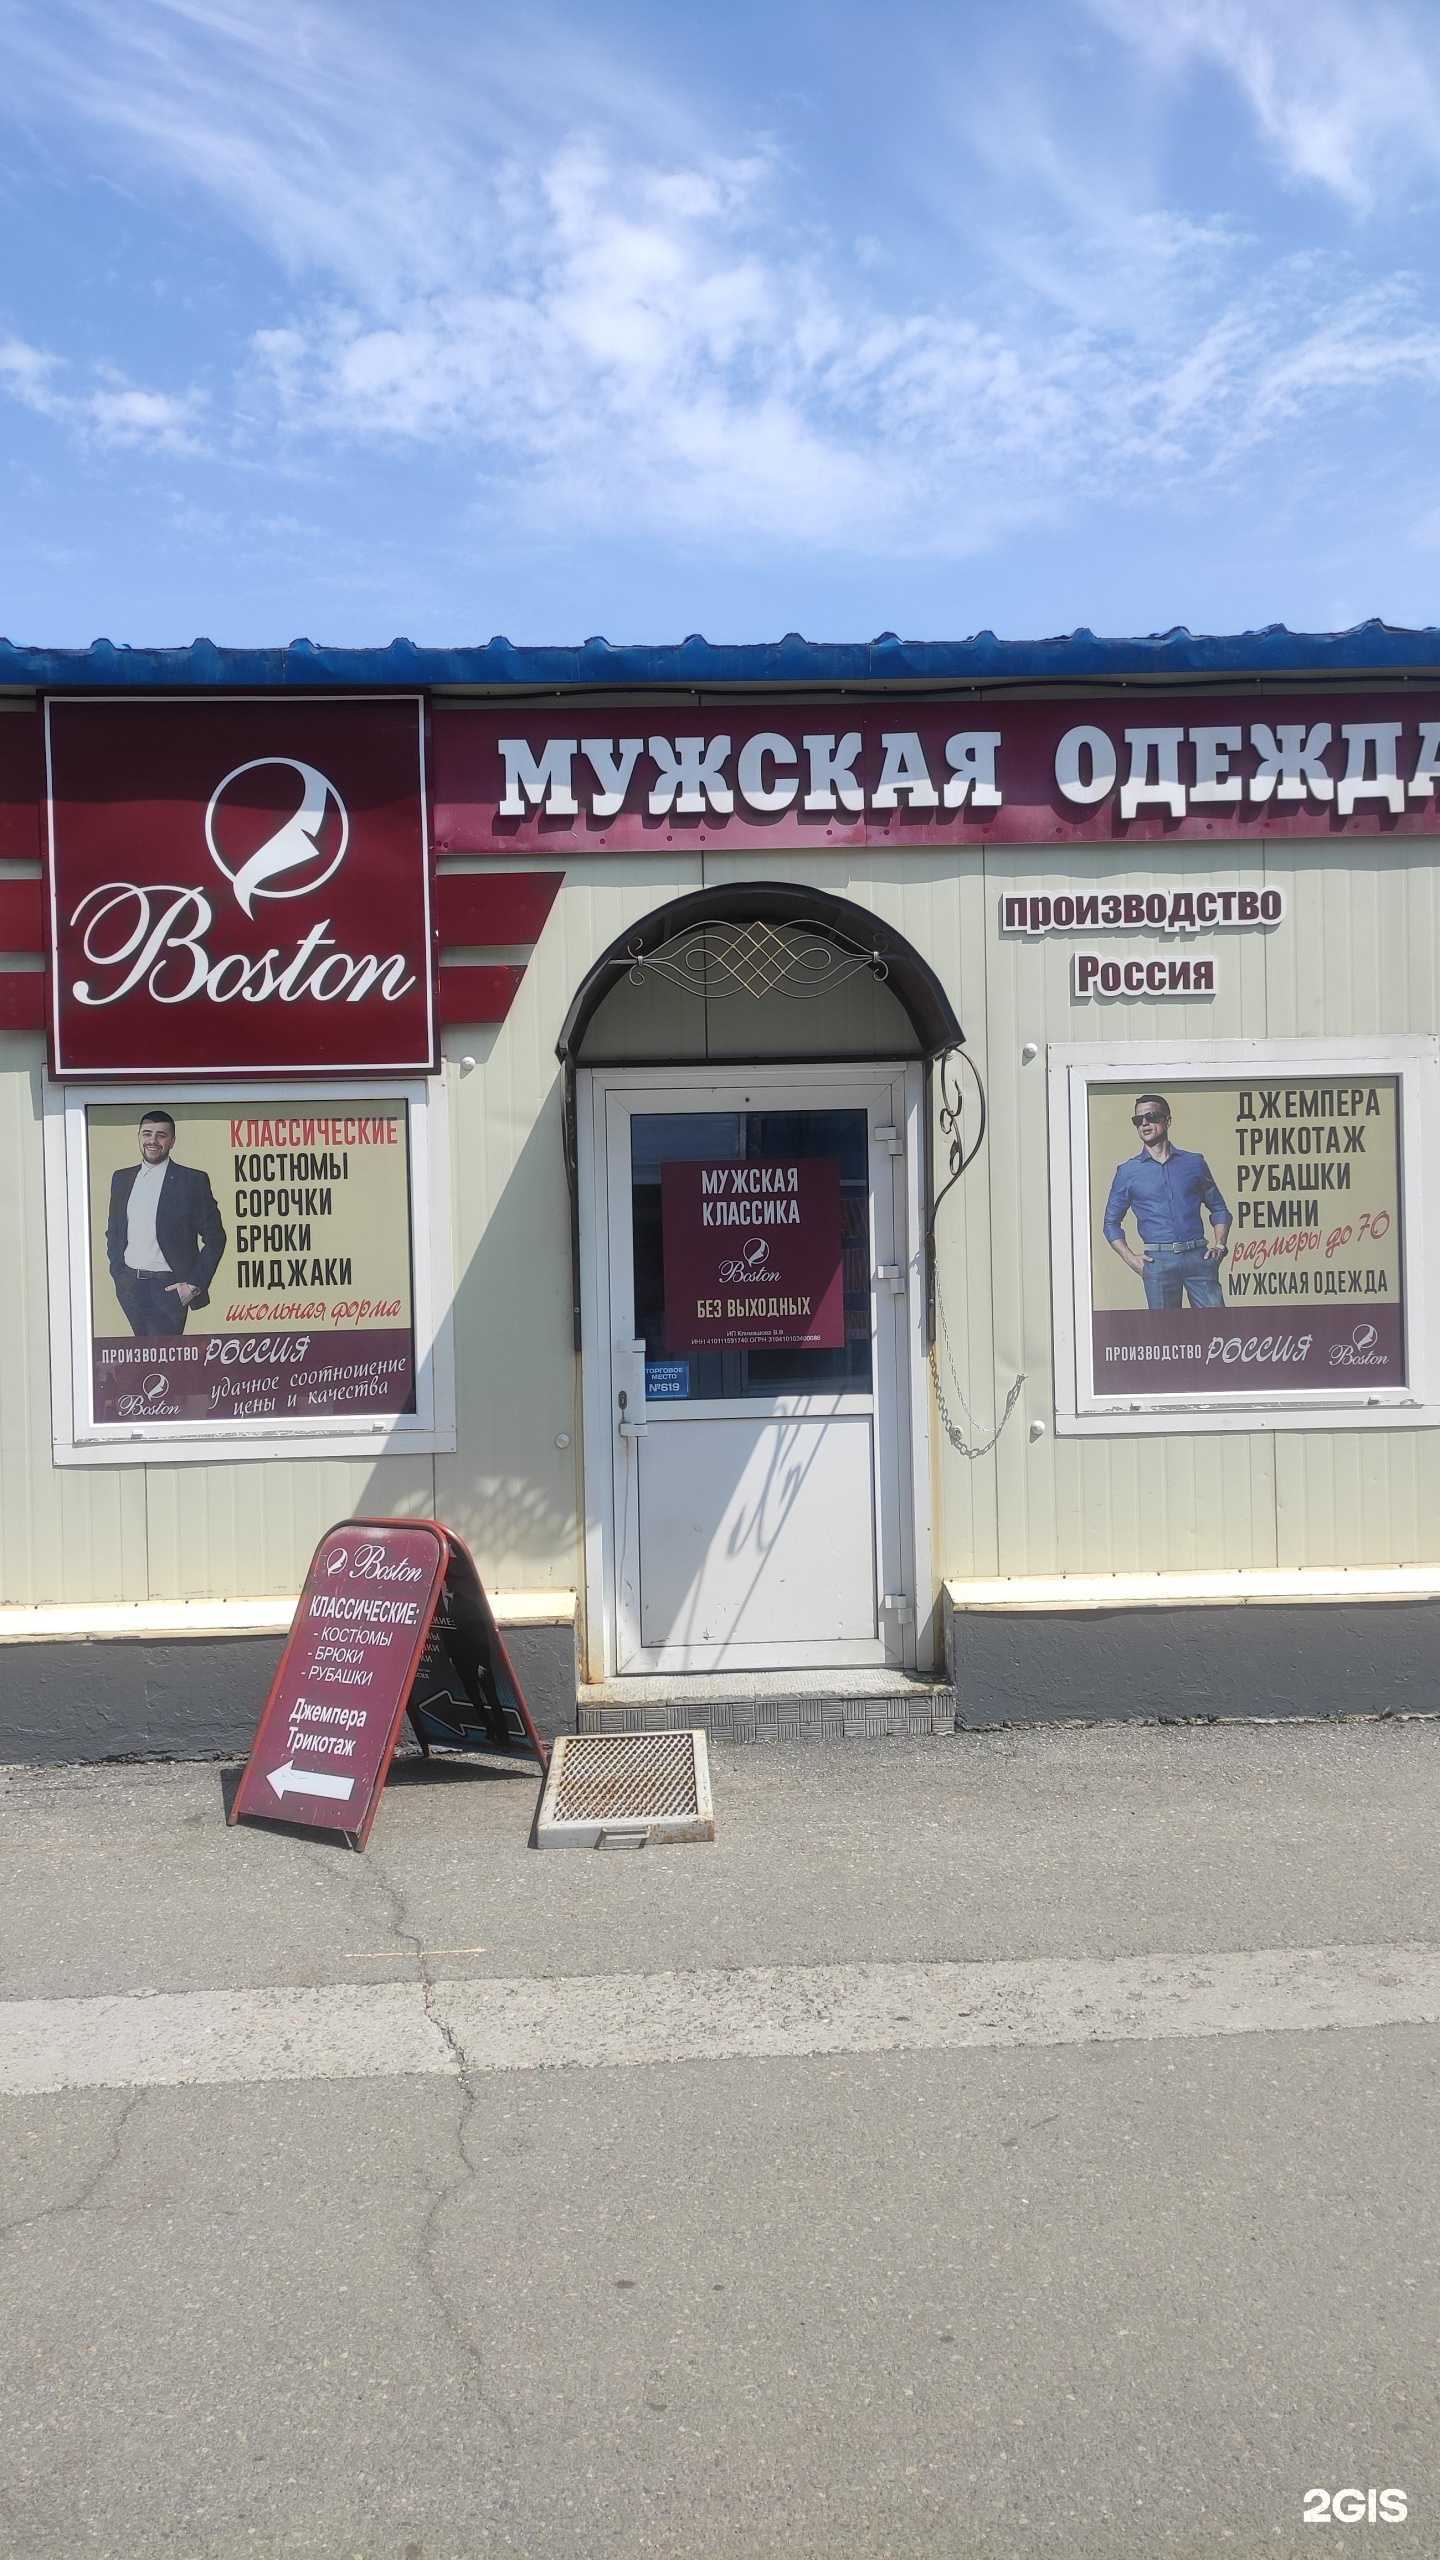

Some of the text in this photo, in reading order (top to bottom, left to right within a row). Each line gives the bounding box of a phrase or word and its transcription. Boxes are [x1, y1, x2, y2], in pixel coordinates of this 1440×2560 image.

[498, 731, 1002, 817] МУЖСКАЯ
[69, 882, 417, 1006] Boston
[1077, 955, 1215, 992] Россия
[1236, 1088, 1381, 1122] ДЖЕМПЕРА
[230, 1116, 398, 1148] КЛАССИЧЕСКИЕ
[1235, 1125, 1367, 1156] ТРИКОТАЖ
[234, 1152, 349, 1182] КОСТЮМЫ
[701, 1168, 799, 1194] МУЖСКАЯ
[1237, 1162, 1351, 1192] РУБАШКИ
[235, 1188, 332, 1217] СОРОЧКИ
[702, 1200, 800, 1226] КЛАССИКА
[1238, 1200, 1319, 1229] РЕМНИ
[236, 1224, 311, 1253] БРЮКИ
[1231, 1210, 1392, 1271] размеры до 70
[237, 1258, 352, 1290] ПИДЖАКИ
[718, 1260, 781, 1283] Boston
[1228, 1269, 1388, 1296] МУЖСКАЯ ОДЕЖДА
[225, 1297, 401, 1326] школьная форма
[697, 1296, 811, 1318] БЕЗ ВЫХОДНЫХ
[102, 1346, 199, 1364] ПРОИЗВОДСТВО
[1105, 1344, 1202, 1362] ПРОИЗВОДСТВО
[1328, 1344, 1390, 1366] Boston
[208, 1358, 406, 1409] удачное соотношение
[233, 1375, 389, 1417] цены и качества
[118, 1394, 181, 1416] Boston
[349, 1543, 423, 1582] Boston
[309, 1595, 420, 1625] КЛАССИЧЕСКИЕ:
[321, 1625, 393, 1647] КОСТЮМЫ
[315, 1646, 364, 1664] БРЮКИ
[308, 1665, 373, 1686] РУБАШКИ
[289, 1697, 367, 1731] Джемпера
[286, 1726, 356, 1757] Трикотаж
